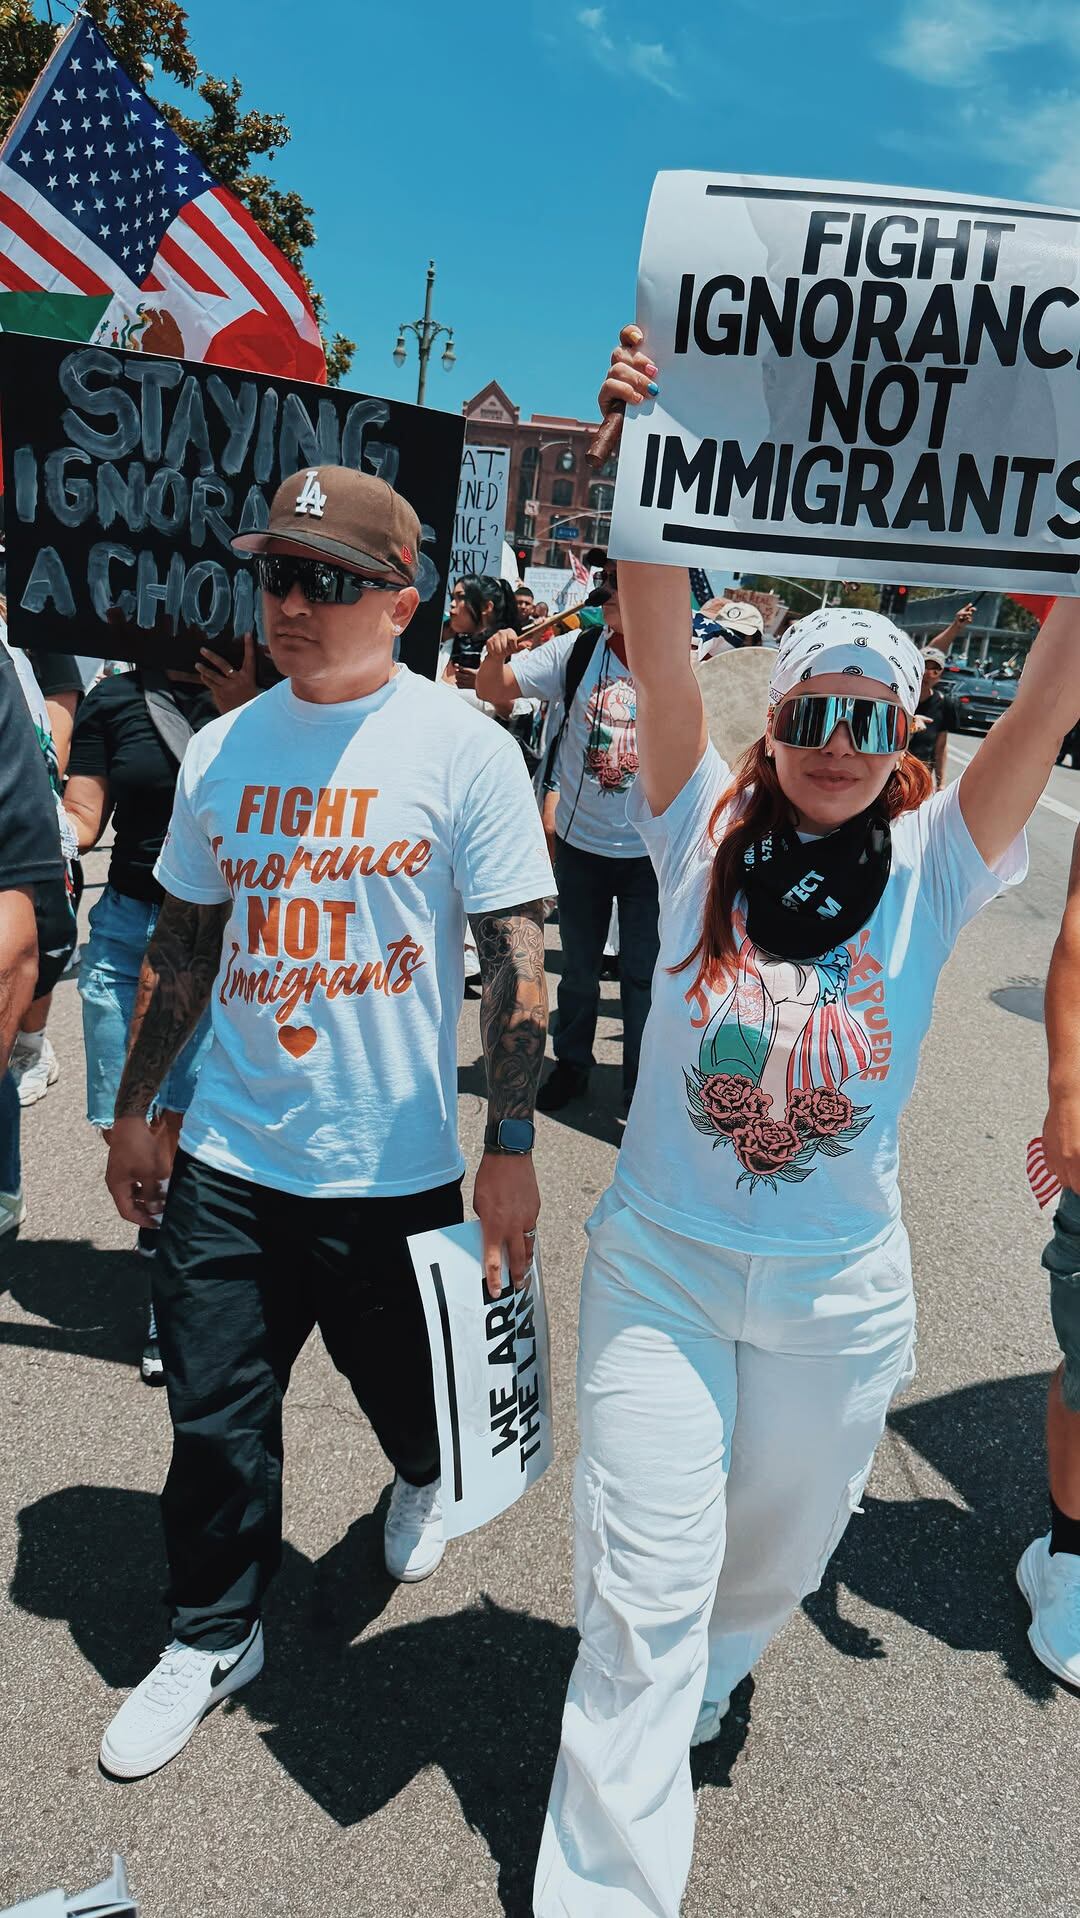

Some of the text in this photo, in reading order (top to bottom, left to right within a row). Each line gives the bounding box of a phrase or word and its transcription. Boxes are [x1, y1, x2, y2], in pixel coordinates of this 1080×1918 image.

[801, 210, 1016, 282] FIGHT
[674, 273, 1080, 370] IGNORANC
[58, 347, 400, 487] STAYING
[807, 361, 968, 450] NOT
[13, 445, 272, 560] IGNORA
[295, 470, 327, 517] LA
[462, 449, 505, 486] AT?
[639, 433, 1080, 540] IMMIGRANTS
[454, 513, 499, 546] TICE?
[20, 541, 270, 645] A CHOI
[235, 785, 379, 838] FIGHT
[247, 895, 356, 962] NOT
[515, 1272, 541, 1473] THE LAN
[489, 1375, 519, 1458] WE
